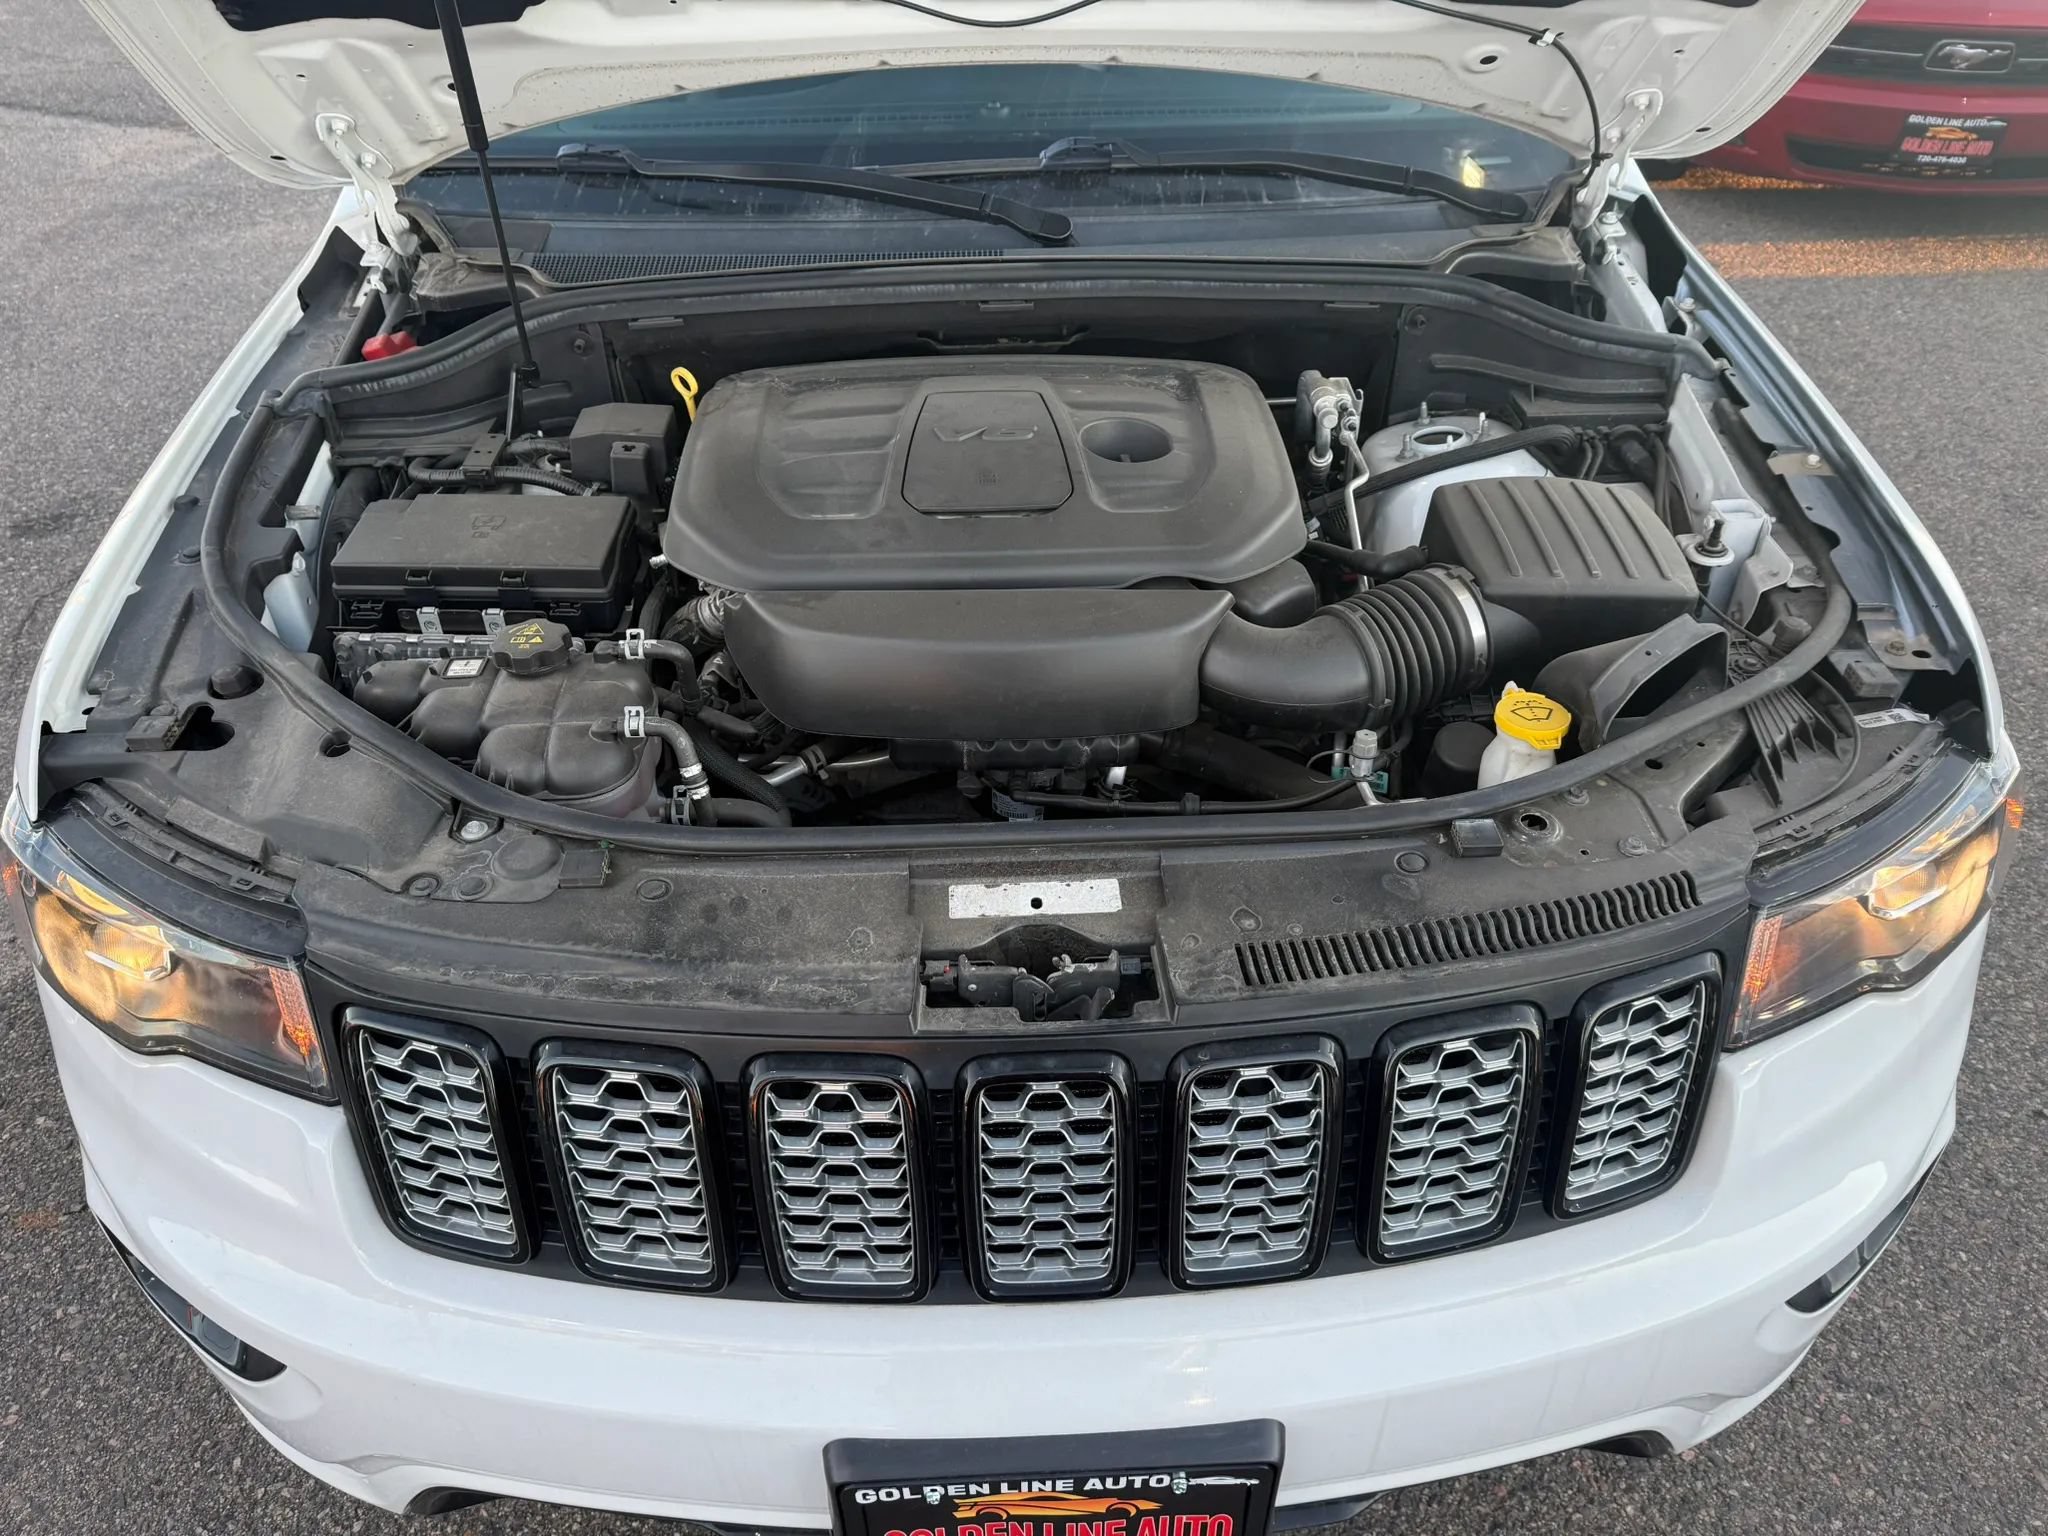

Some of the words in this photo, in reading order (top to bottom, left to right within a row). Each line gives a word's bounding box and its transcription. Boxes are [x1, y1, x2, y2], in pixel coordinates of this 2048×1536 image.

[1908, 114, 1943, 126] GOLDEN
[1943, 118, 1963, 127] LINE
[1963, 118, 1988, 127] AUTO
[854, 1483, 991, 1505] GOLDEN
[1000, 1479, 1074, 1494] LINE
[1083, 1474, 1171, 1491] AUTO
[884, 1521, 1034, 1536] DEN
